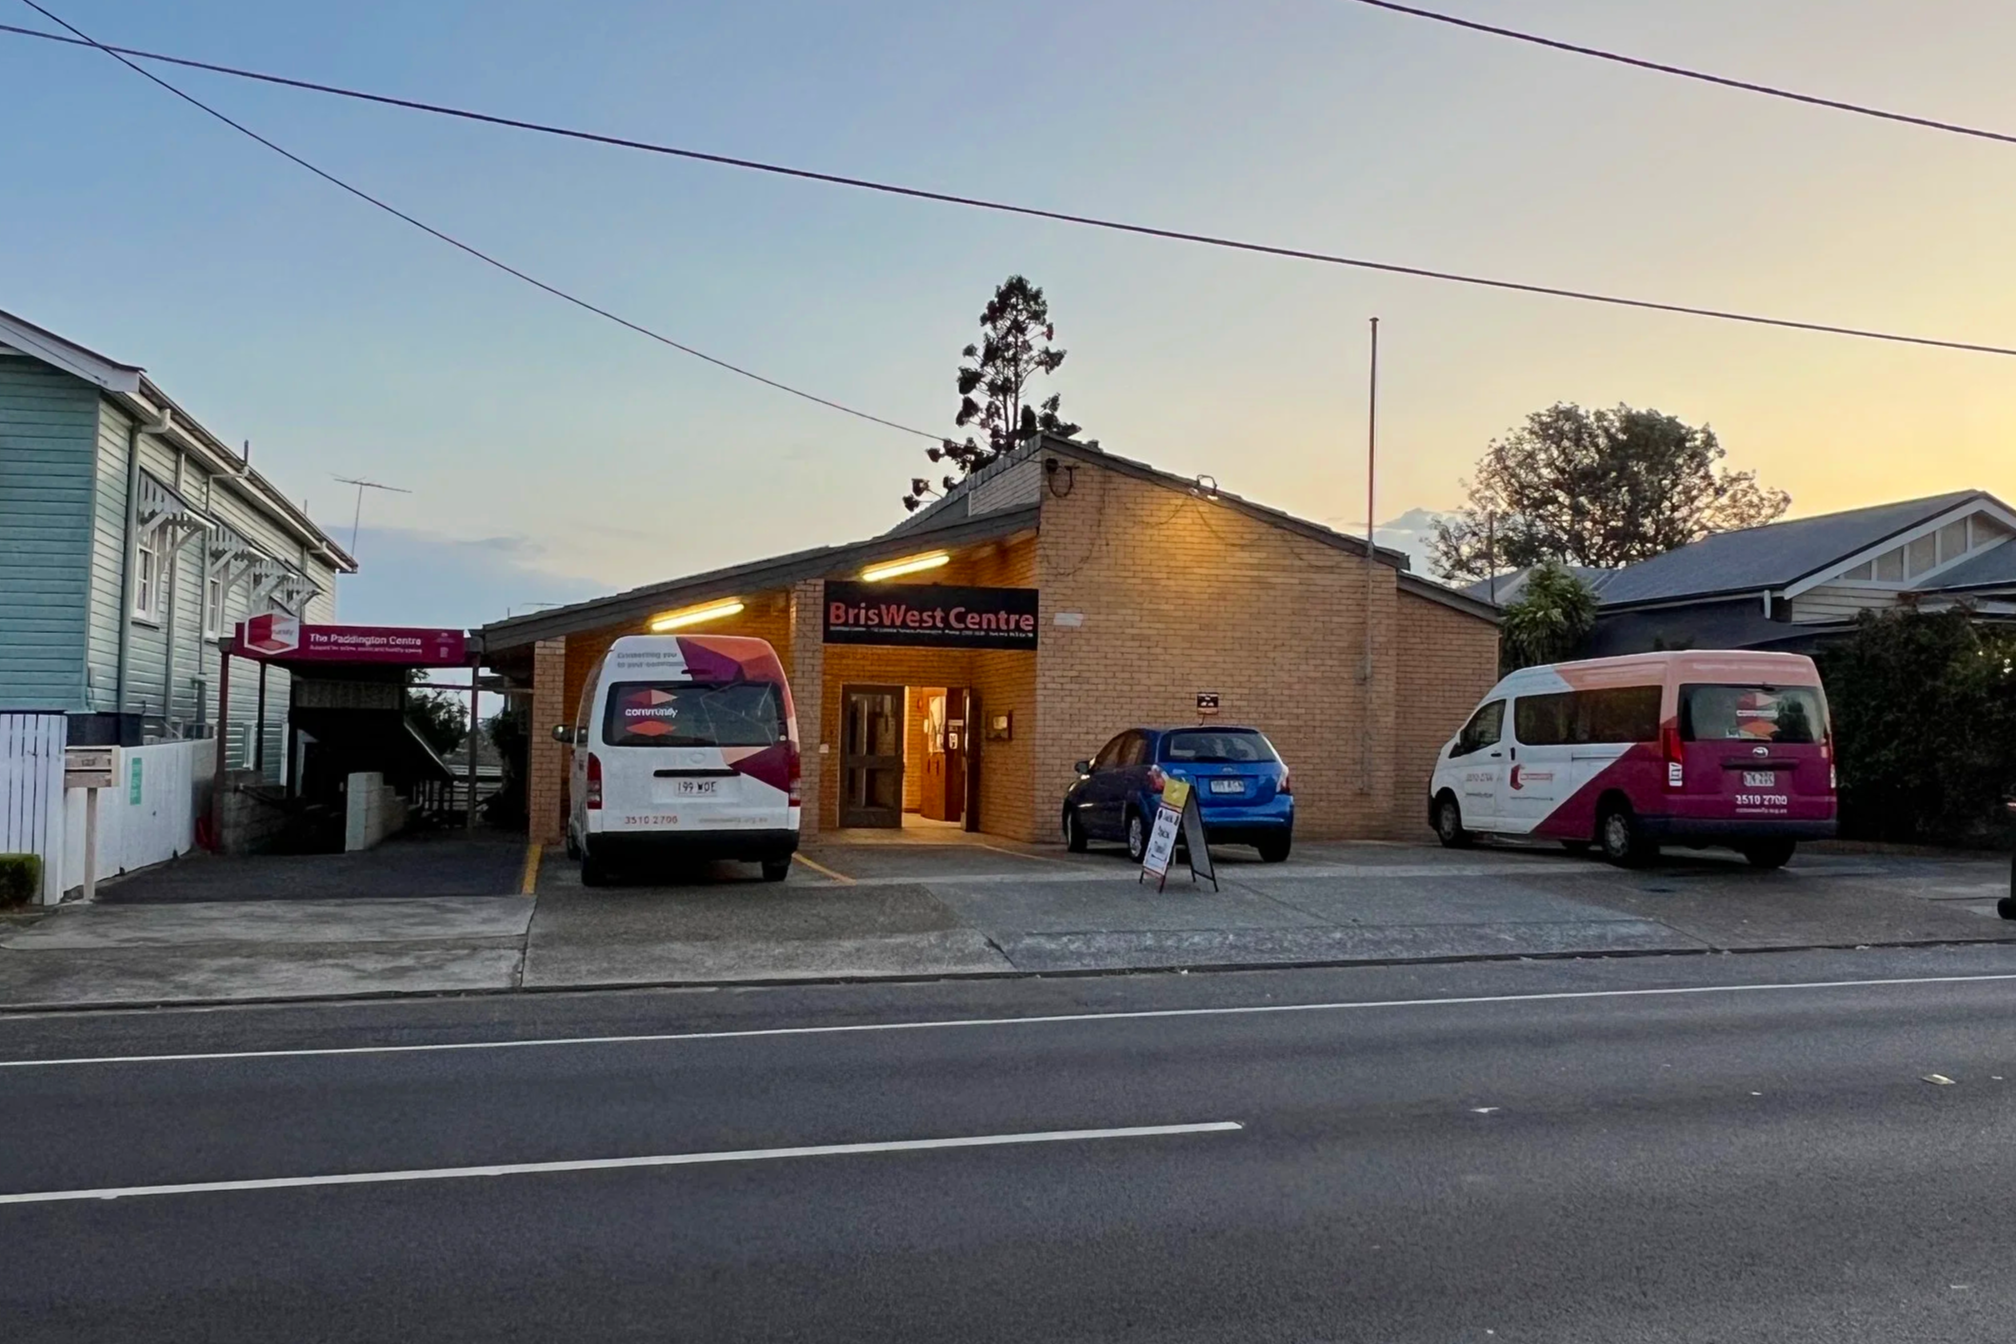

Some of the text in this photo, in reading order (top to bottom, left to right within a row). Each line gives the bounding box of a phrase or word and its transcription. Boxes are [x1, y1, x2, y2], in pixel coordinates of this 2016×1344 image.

[829, 602, 1034, 631] BrisWest Centre
[310, 633, 422, 647] The Paddington Centre
[1735, 794, 1761, 805] 3510
[624, 815, 650, 825] 3510
